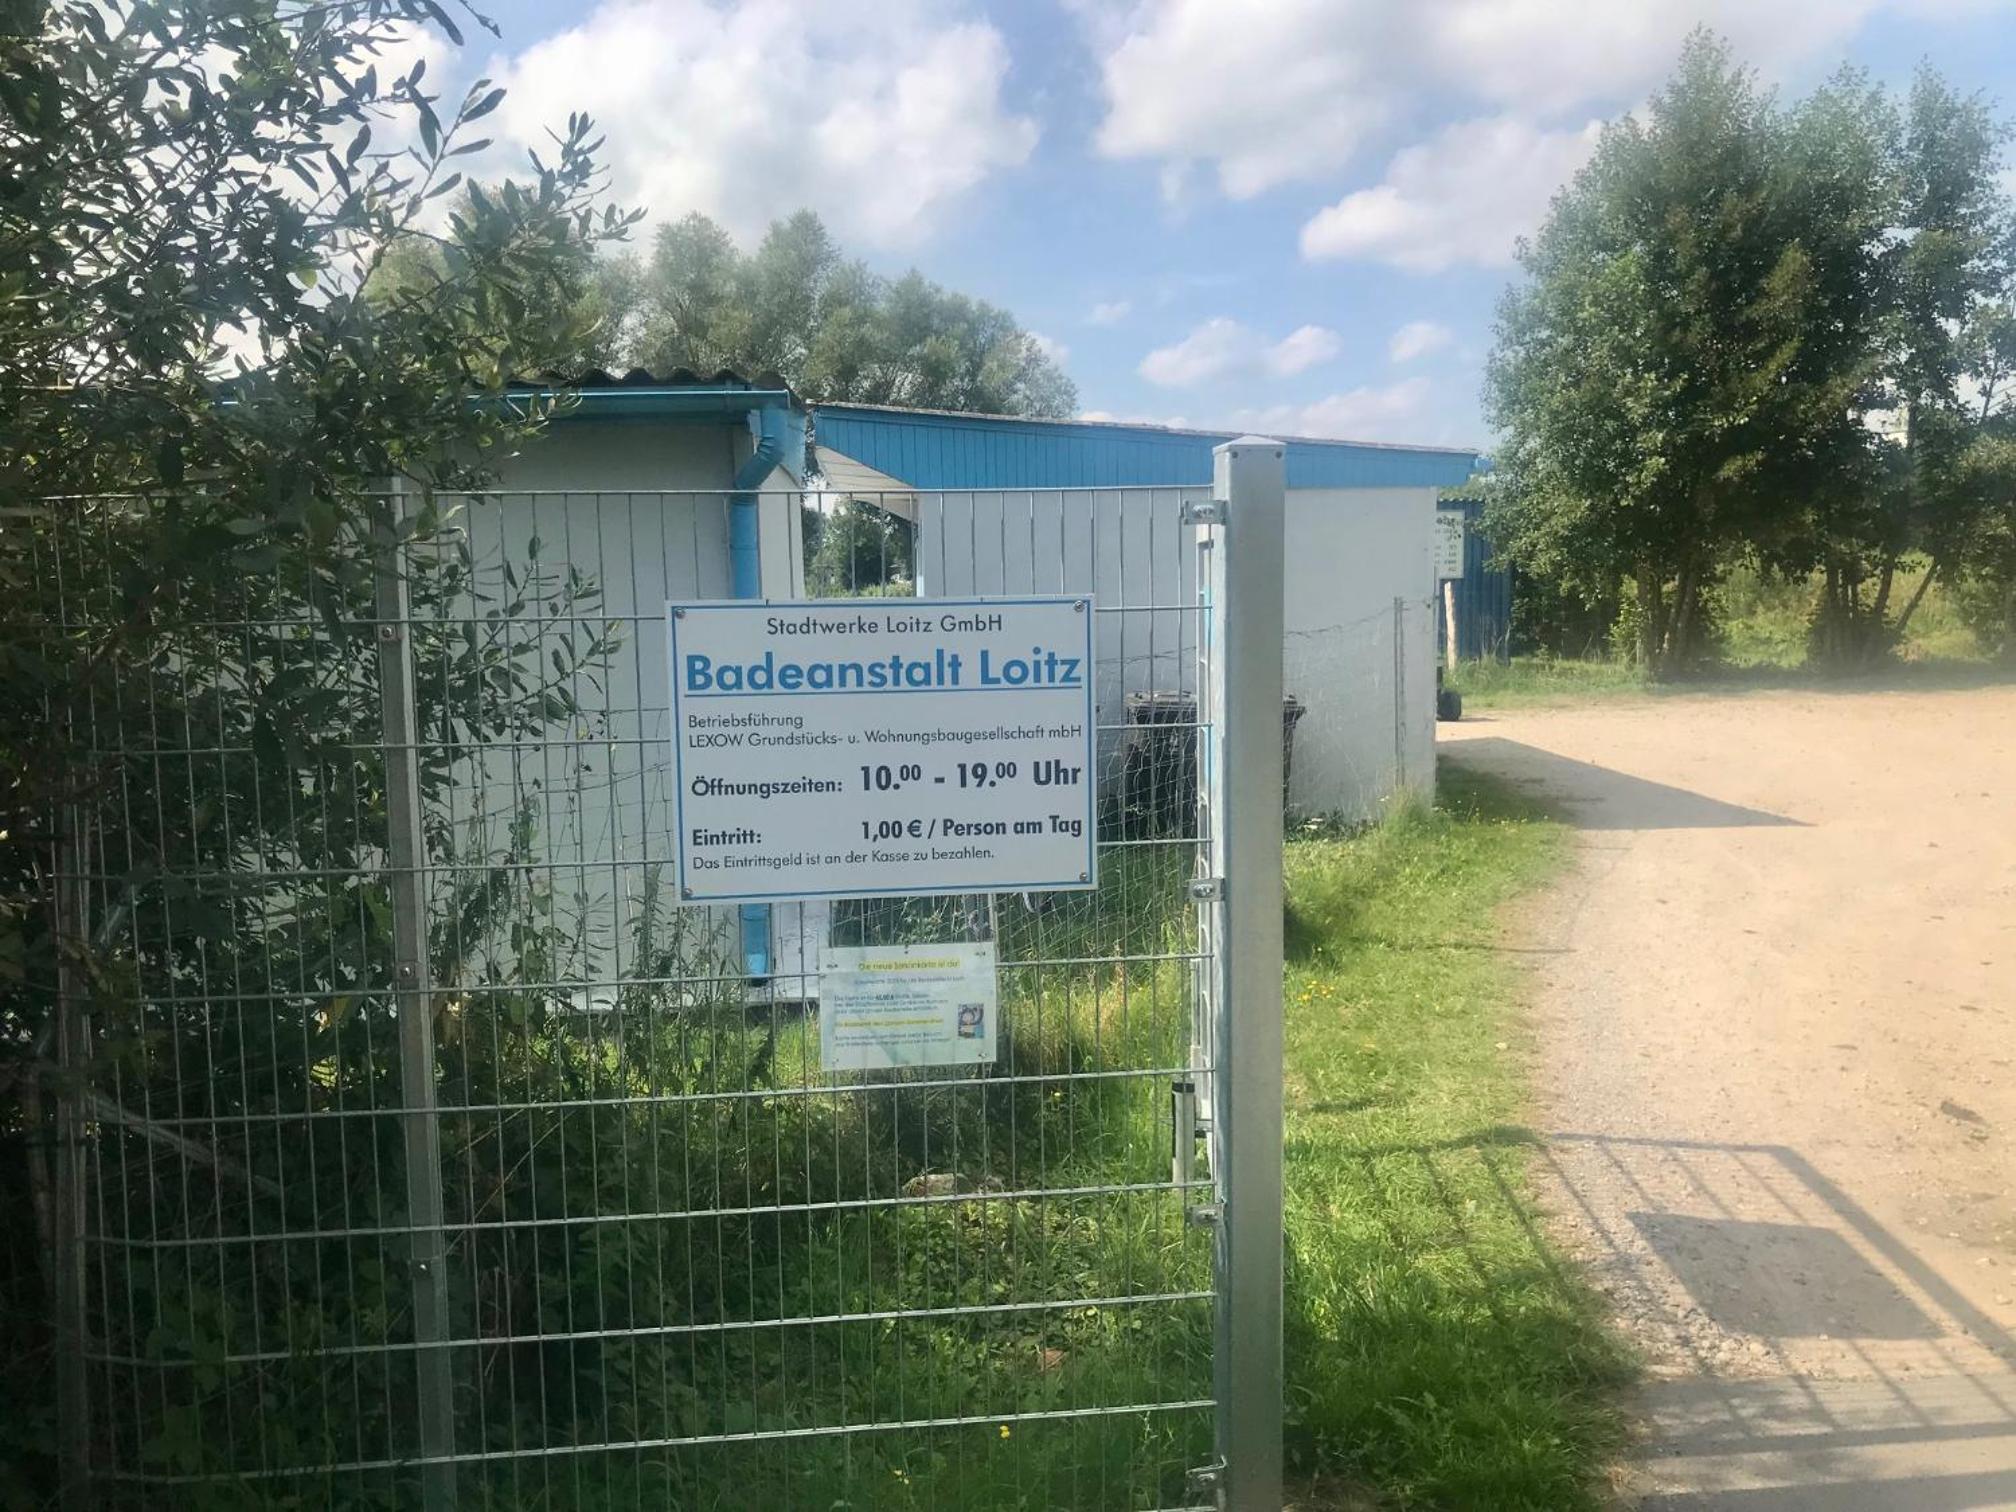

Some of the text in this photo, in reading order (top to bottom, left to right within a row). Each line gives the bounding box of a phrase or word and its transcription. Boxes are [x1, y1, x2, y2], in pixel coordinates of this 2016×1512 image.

[767, 614, 1001, 635] Stadtwerke Loitz GmbH
[687, 647, 1081, 691] Badeanstalt Loitz
[689, 713, 803, 729] Betriebsführung
[689, 725, 1081, 748] LEXOW Grundstücks- u. Wohnungsbaugesellschaft mbH
[692, 776, 842, 799] Öffnungszeiten:
[1033, 759, 1081, 785] Uhr
[693, 828, 761, 846] Eintritt:
[862, 821, 902, 842] 1,00
[928, 819, 936, 839] /
[943, 819, 1006, 836] Person
[1013, 821, 1042, 834] am
[1049, 815, 1082, 837] Tag
[693, 846, 994, 870] Das Eintrittsgeld ist an der Kasse zu bezahlen.
